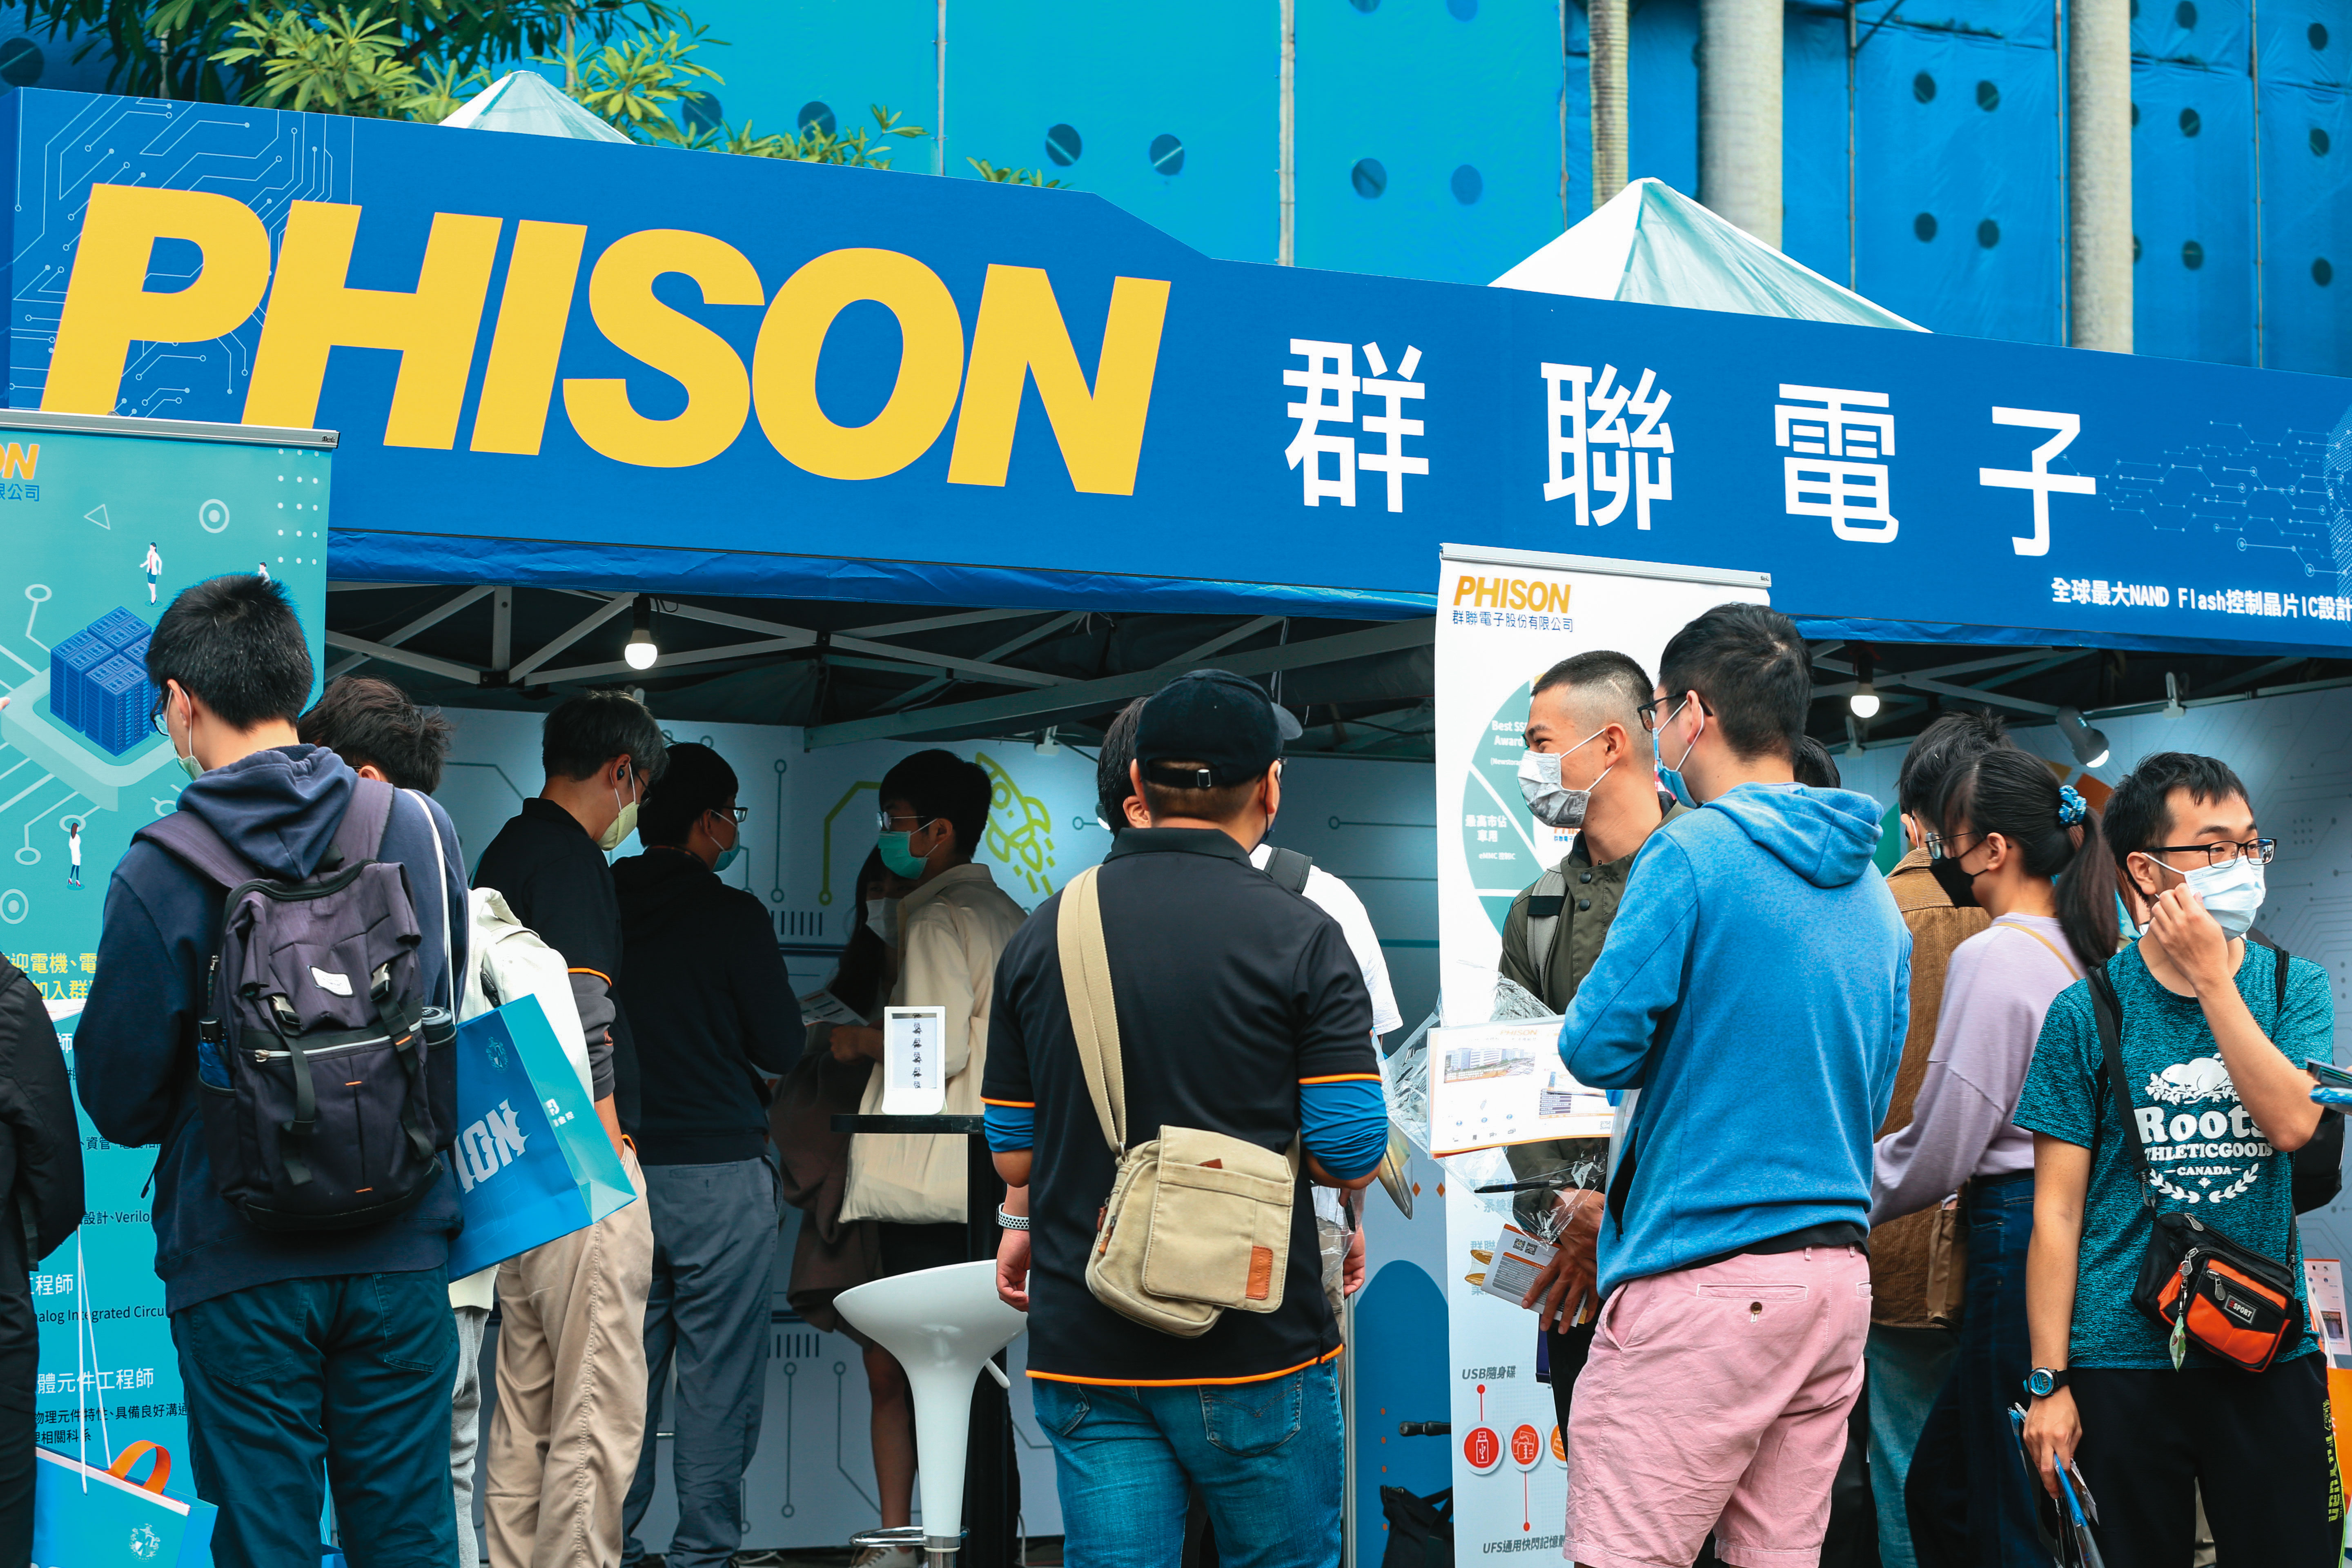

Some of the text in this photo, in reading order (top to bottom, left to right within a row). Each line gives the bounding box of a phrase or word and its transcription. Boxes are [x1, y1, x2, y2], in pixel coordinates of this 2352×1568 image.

[39, 183, 1171, 496] PHISON
[1283, 338, 2097, 556] 群聯電子
[1453, 575, 1571, 613] PHISON
[2051, 577, 2169, 608] 全球最大NAND
[1452, 610, 1573, 633] 群聯電子股份有限公司
[1492, 720, 1513, 731] Best
[1494, 735, 1523, 746] Award
[2177, 1166, 2232, 1176] CANADA
[1462, 1365, 1516, 1380] USB隨身碟
